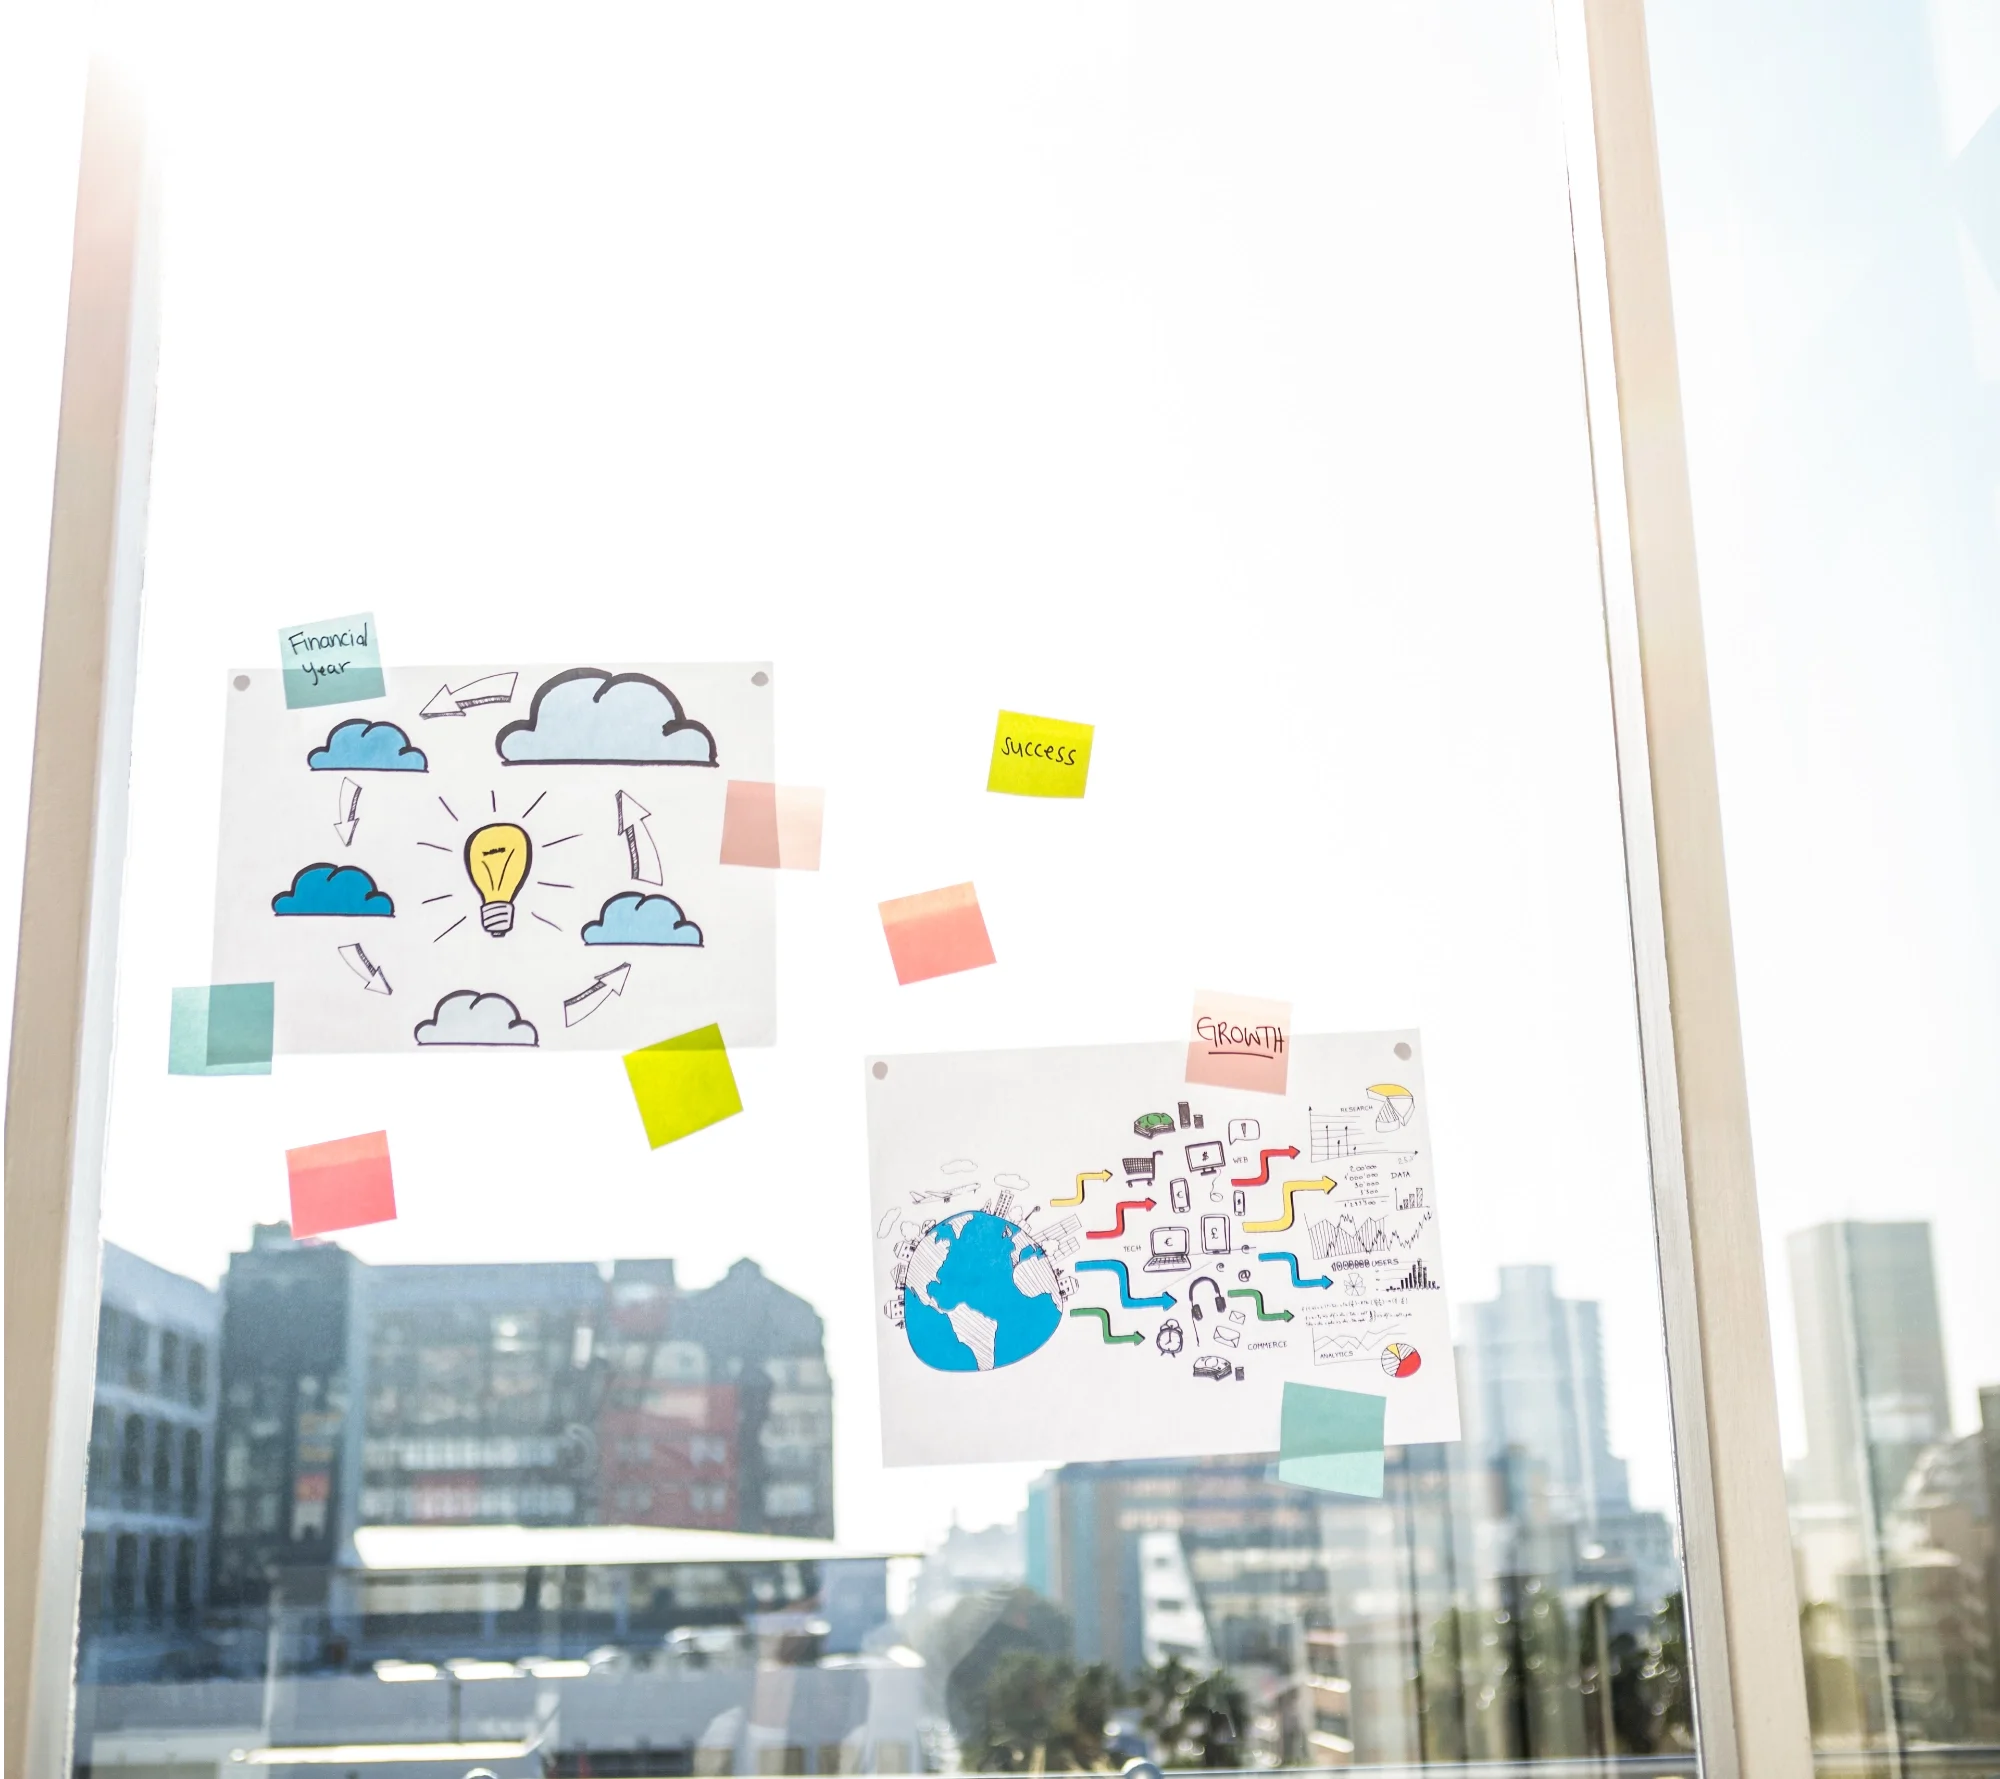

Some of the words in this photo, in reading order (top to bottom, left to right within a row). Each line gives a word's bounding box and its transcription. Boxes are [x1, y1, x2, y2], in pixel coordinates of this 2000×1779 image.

[287, 622, 367, 655] Financial
[1196, 1016, 1285, 1053] GROWTH
[1340, 1105, 1374, 1113] RESEARCH
[1232, 1156, 1249, 1164] WEB
[1390, 1171, 1411, 1180] DATA
[1123, 1245, 1142, 1253] TECH
[1371, 1258, 1400, 1268] USERS
[1247, 1340, 1288, 1351] COMMERCE
[1320, 1350, 1354, 1359] ANALYTICS
